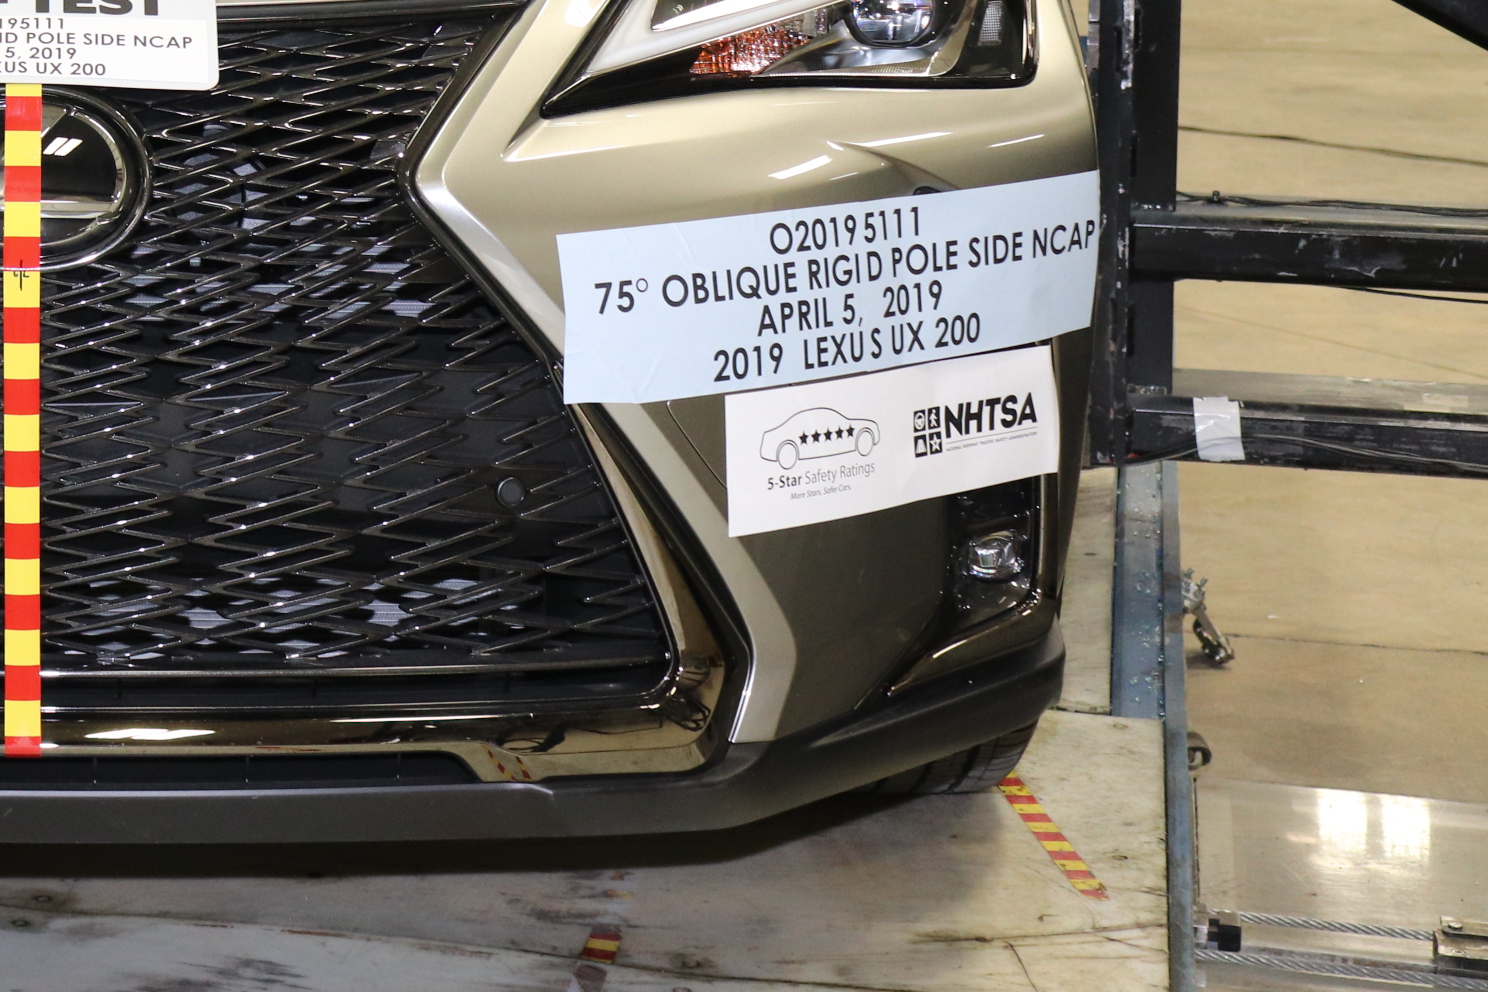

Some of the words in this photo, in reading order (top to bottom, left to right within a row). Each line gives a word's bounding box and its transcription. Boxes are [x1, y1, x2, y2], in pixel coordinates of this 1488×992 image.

[4, 46, 22, 60] 5,
[29, 47, 77, 60] 2019
[26, 32, 76, 45] POLE
[83, 33, 126, 47] SIDE
[133, 35, 193, 49] NCAP
[36, 62, 63, 75] UX
[70, 63, 106, 76] 200
[662, 261, 798, 308] OBLIQUE
[807, 251, 883, 291] RIGID
[891, 240, 958, 278] POLE
[968, 231, 1023, 268] SIDE
[1032, 219, 1096, 259] NCAP
[757, 297, 834, 337] APRIL
[842, 293, 864, 328] 5,
[883, 279, 943, 318] 2019
[714, 342, 784, 382] 2019
[803, 327, 882, 370] LEXUS
[891, 320, 925, 355] UX
[934, 312, 981, 349] 200
[944, 392, 1038, 439] NHTSA
[767, 475, 802, 491] 5-Star
[804, 468, 837, 485] Safety
[839, 462, 875, 478] Ratings
[790, 492, 806, 500] More
[823, 486, 837, 495] Safer
